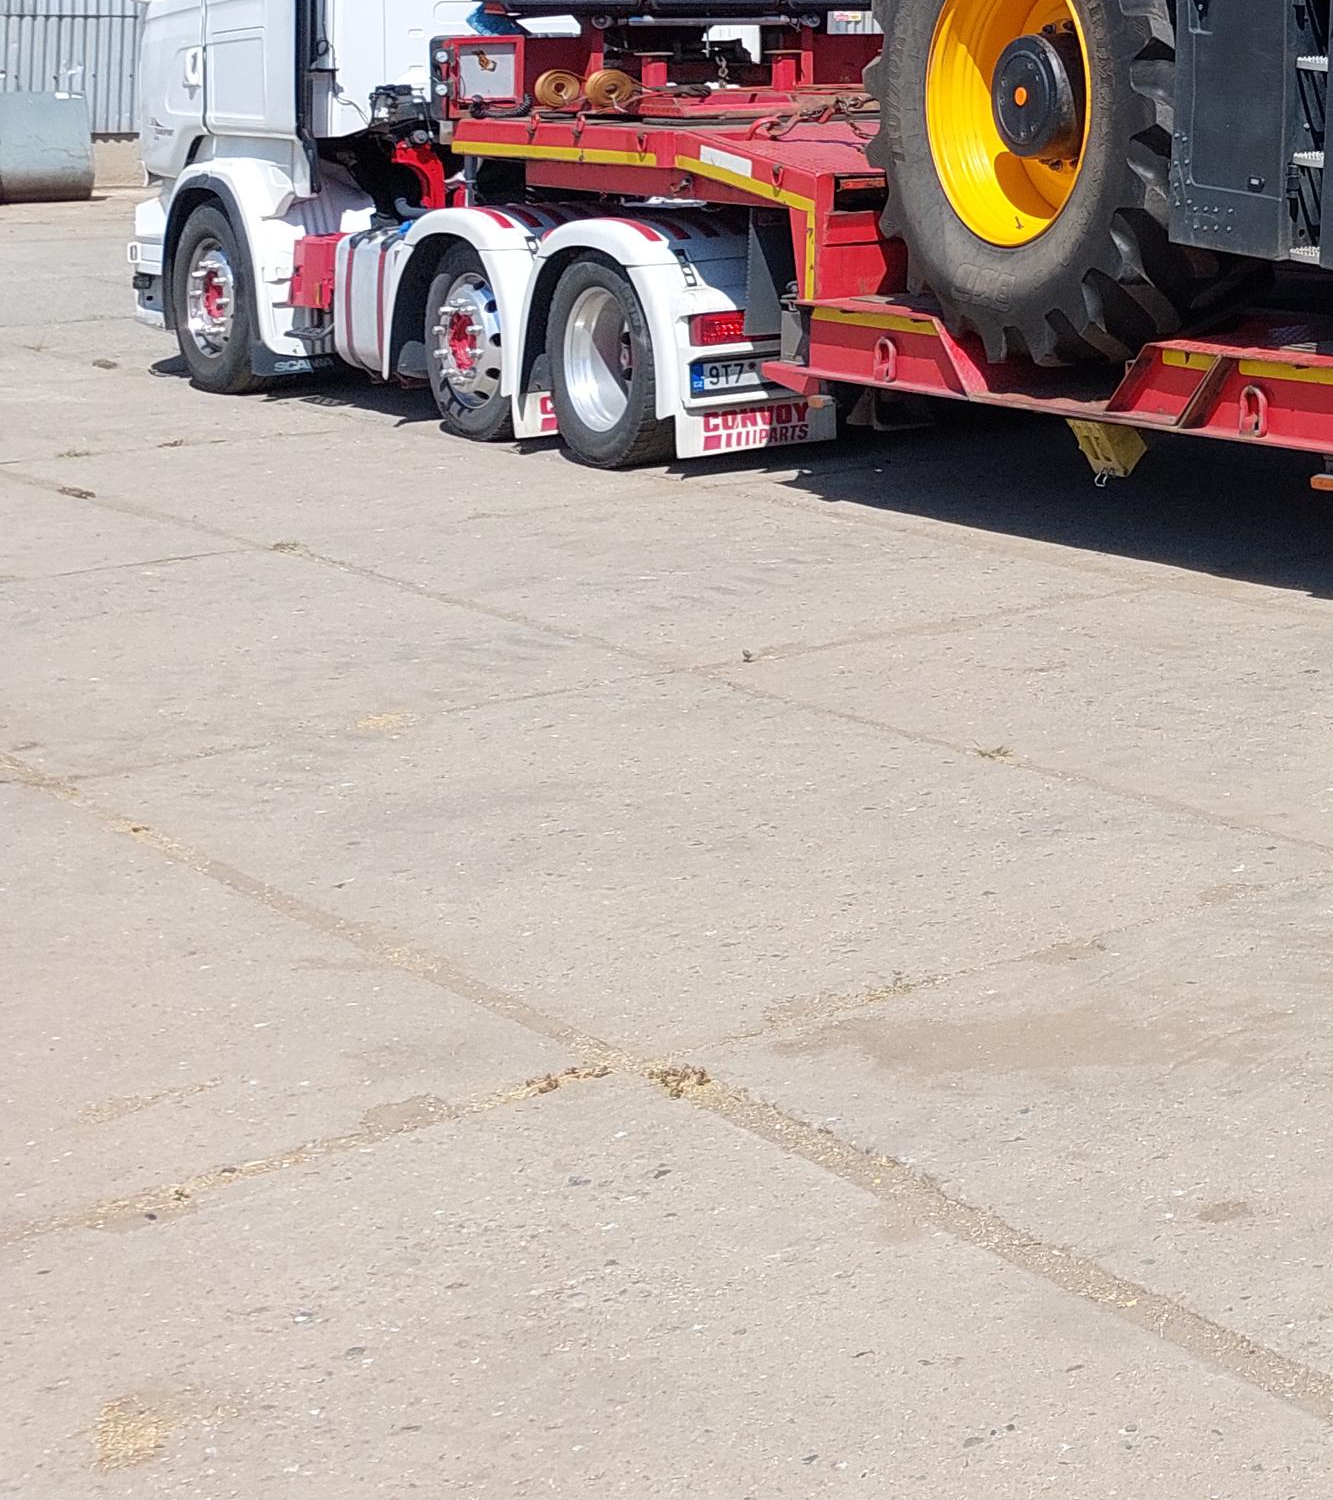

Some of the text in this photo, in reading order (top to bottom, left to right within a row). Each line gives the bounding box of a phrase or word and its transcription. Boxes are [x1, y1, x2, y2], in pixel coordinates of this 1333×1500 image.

[708, 362, 745, 386] 9T7
[702, 402, 810, 434] CONVOY
[759, 422, 809, 445] PARTS
